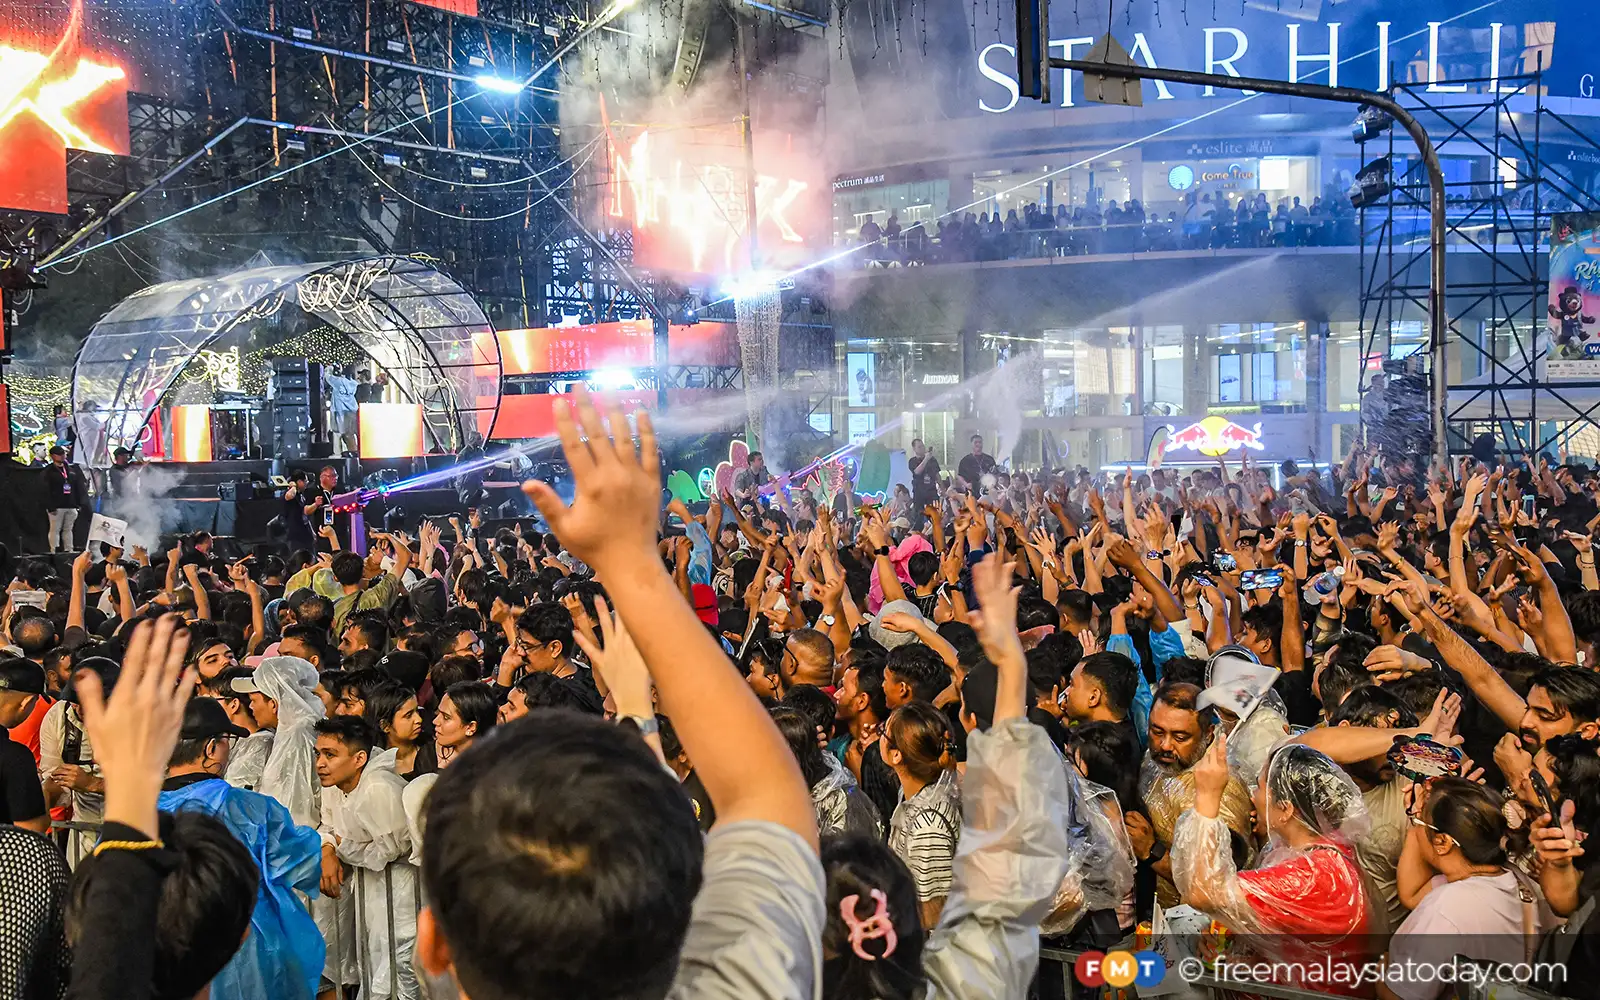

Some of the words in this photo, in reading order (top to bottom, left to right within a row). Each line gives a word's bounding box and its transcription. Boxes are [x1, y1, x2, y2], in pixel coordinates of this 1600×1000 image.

[978, 21, 1526, 113] STARHILL
[1205, 141, 1244, 154] eslite
[833, 178, 863, 192] pectrum
[1574, 260, 1600, 281] Rh
